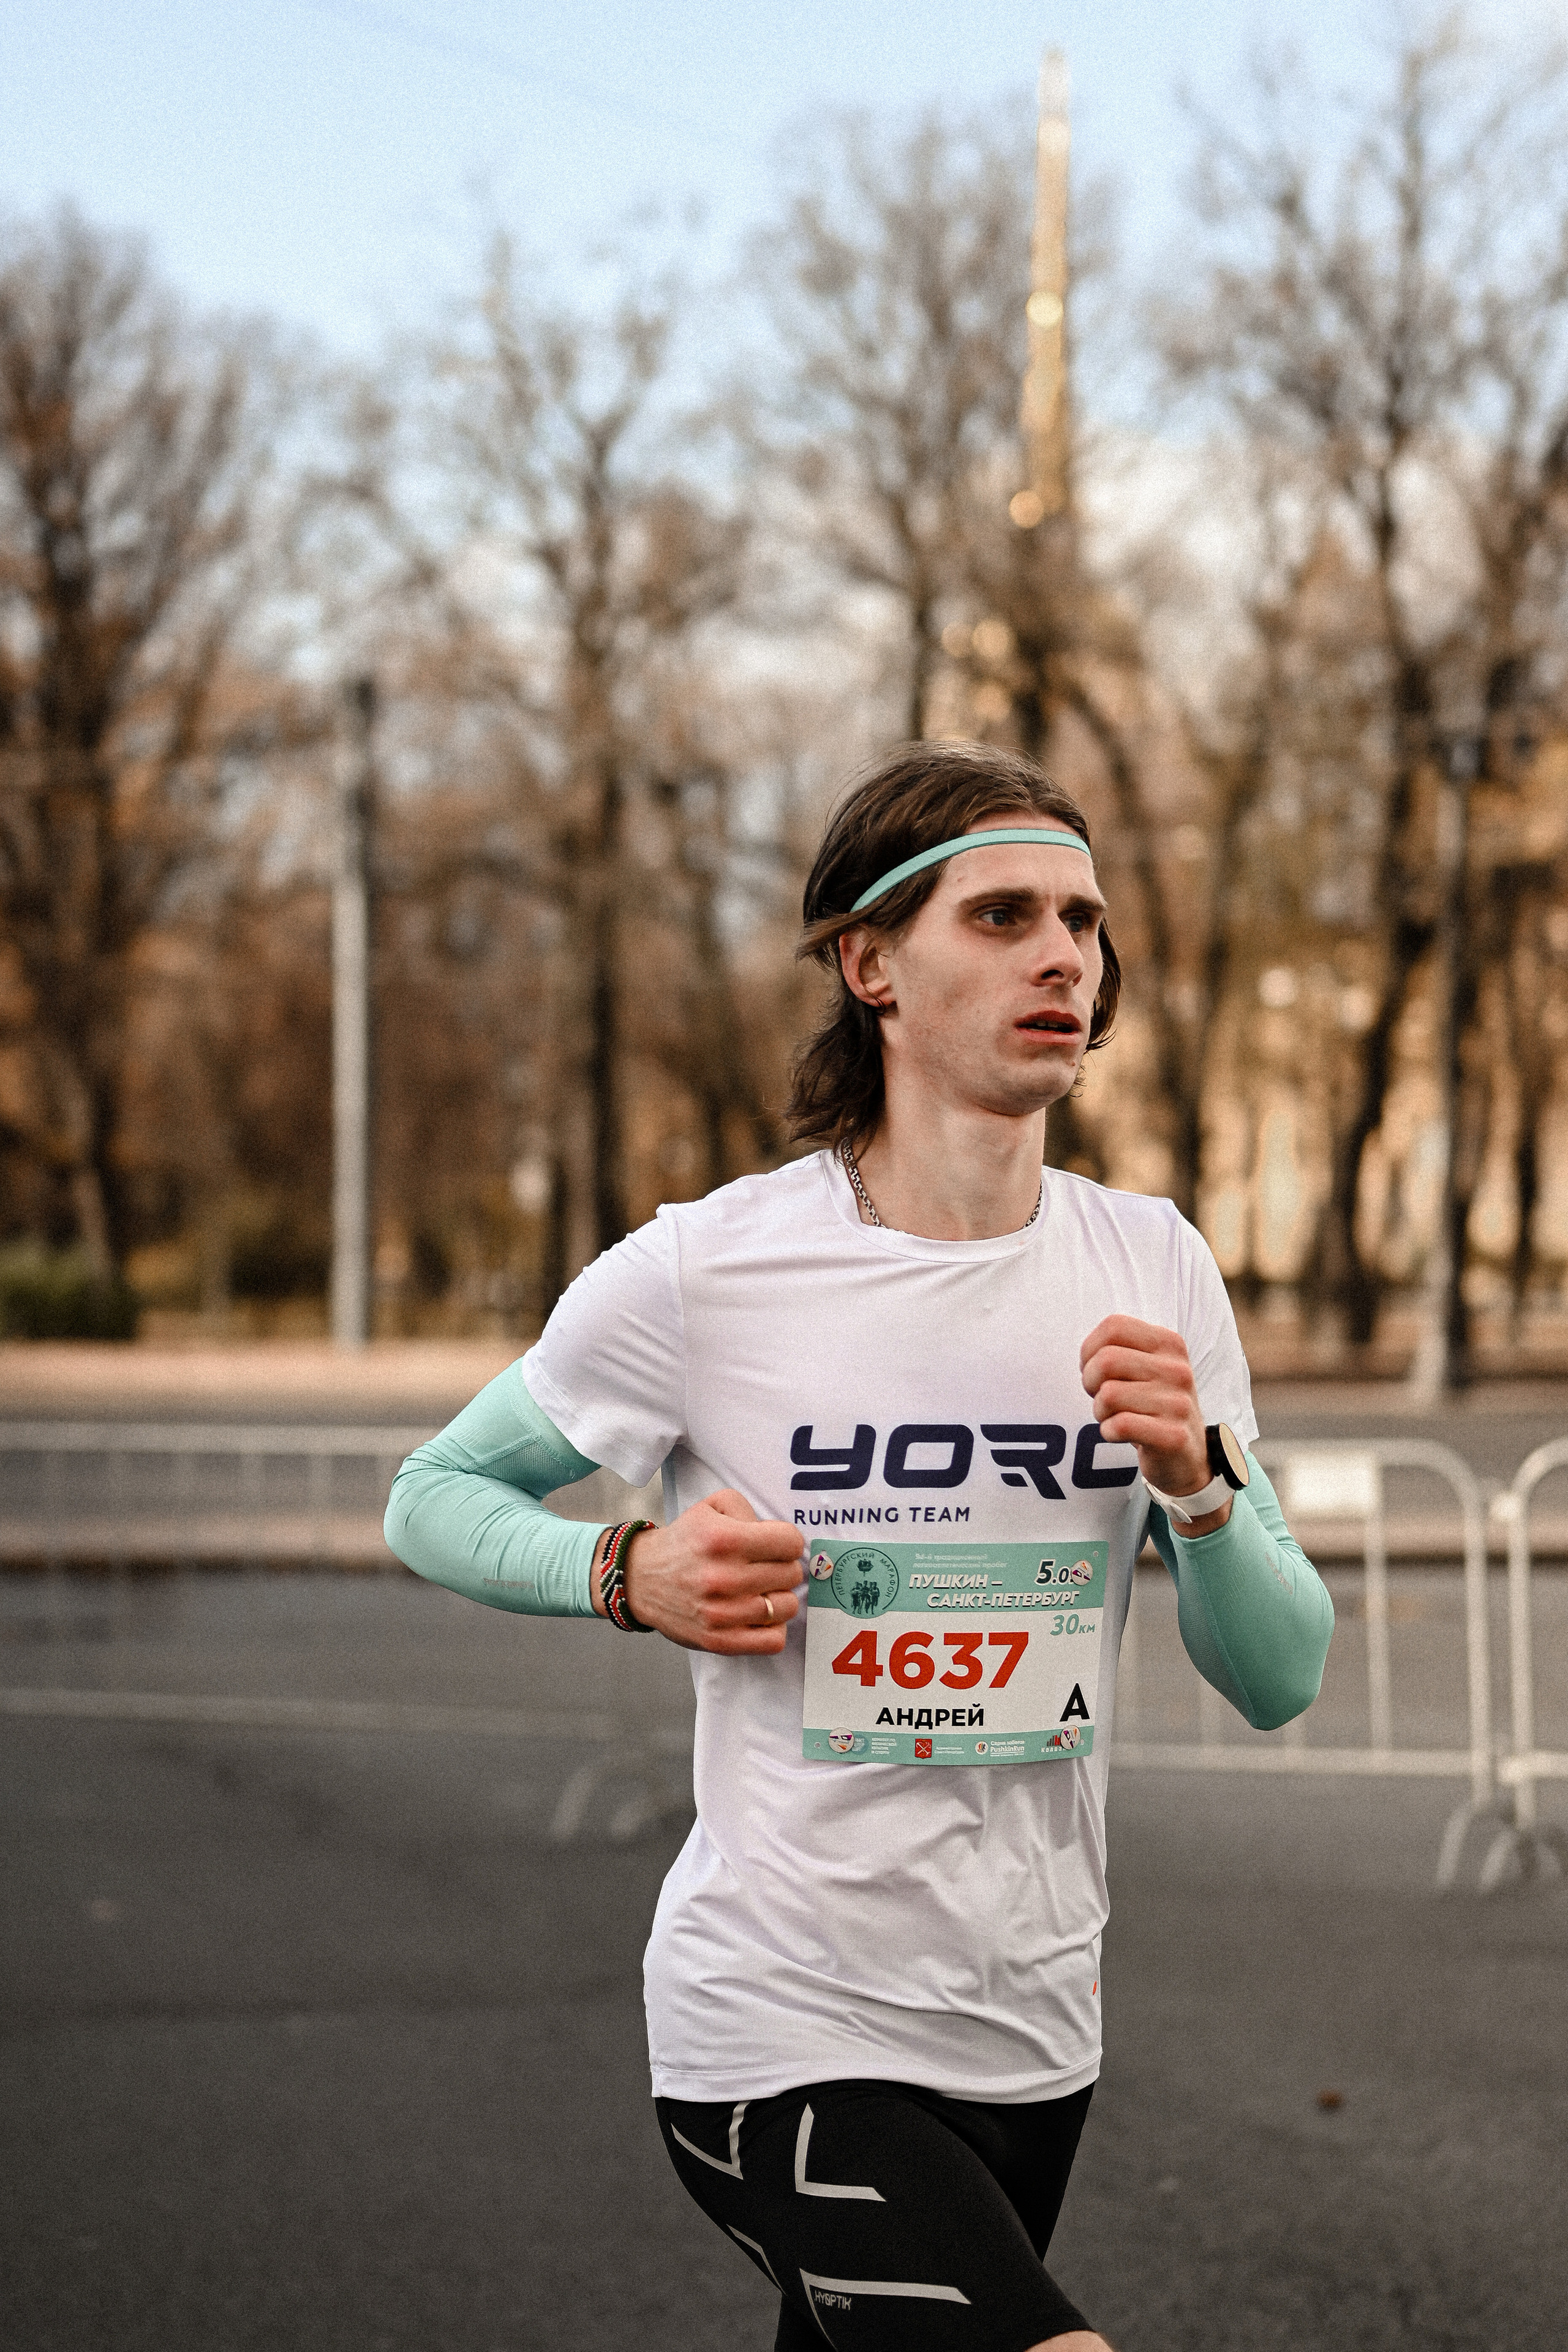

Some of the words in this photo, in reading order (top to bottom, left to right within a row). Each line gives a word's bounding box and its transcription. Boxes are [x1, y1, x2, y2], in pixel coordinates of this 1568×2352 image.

[794, 1507, 899, 1525] RUNNING
[909, 1507, 970, 1522] TEAM
[834, 1552, 875, 1596] ПЕТЕРБУРГСКИЙ
[879, 1558, 896, 1598] МАРАФОН
[909, 1574, 989, 1589] ПУШКИН
[1035, 1559, 1075, 1585] 5.0
[927, 1591, 1080, 1608] САНКТ-ПЕТЕРБУРГ
[831, 1630, 1029, 1690] 4637
[875, 1703, 984, 1730] АНДРЕЙ
